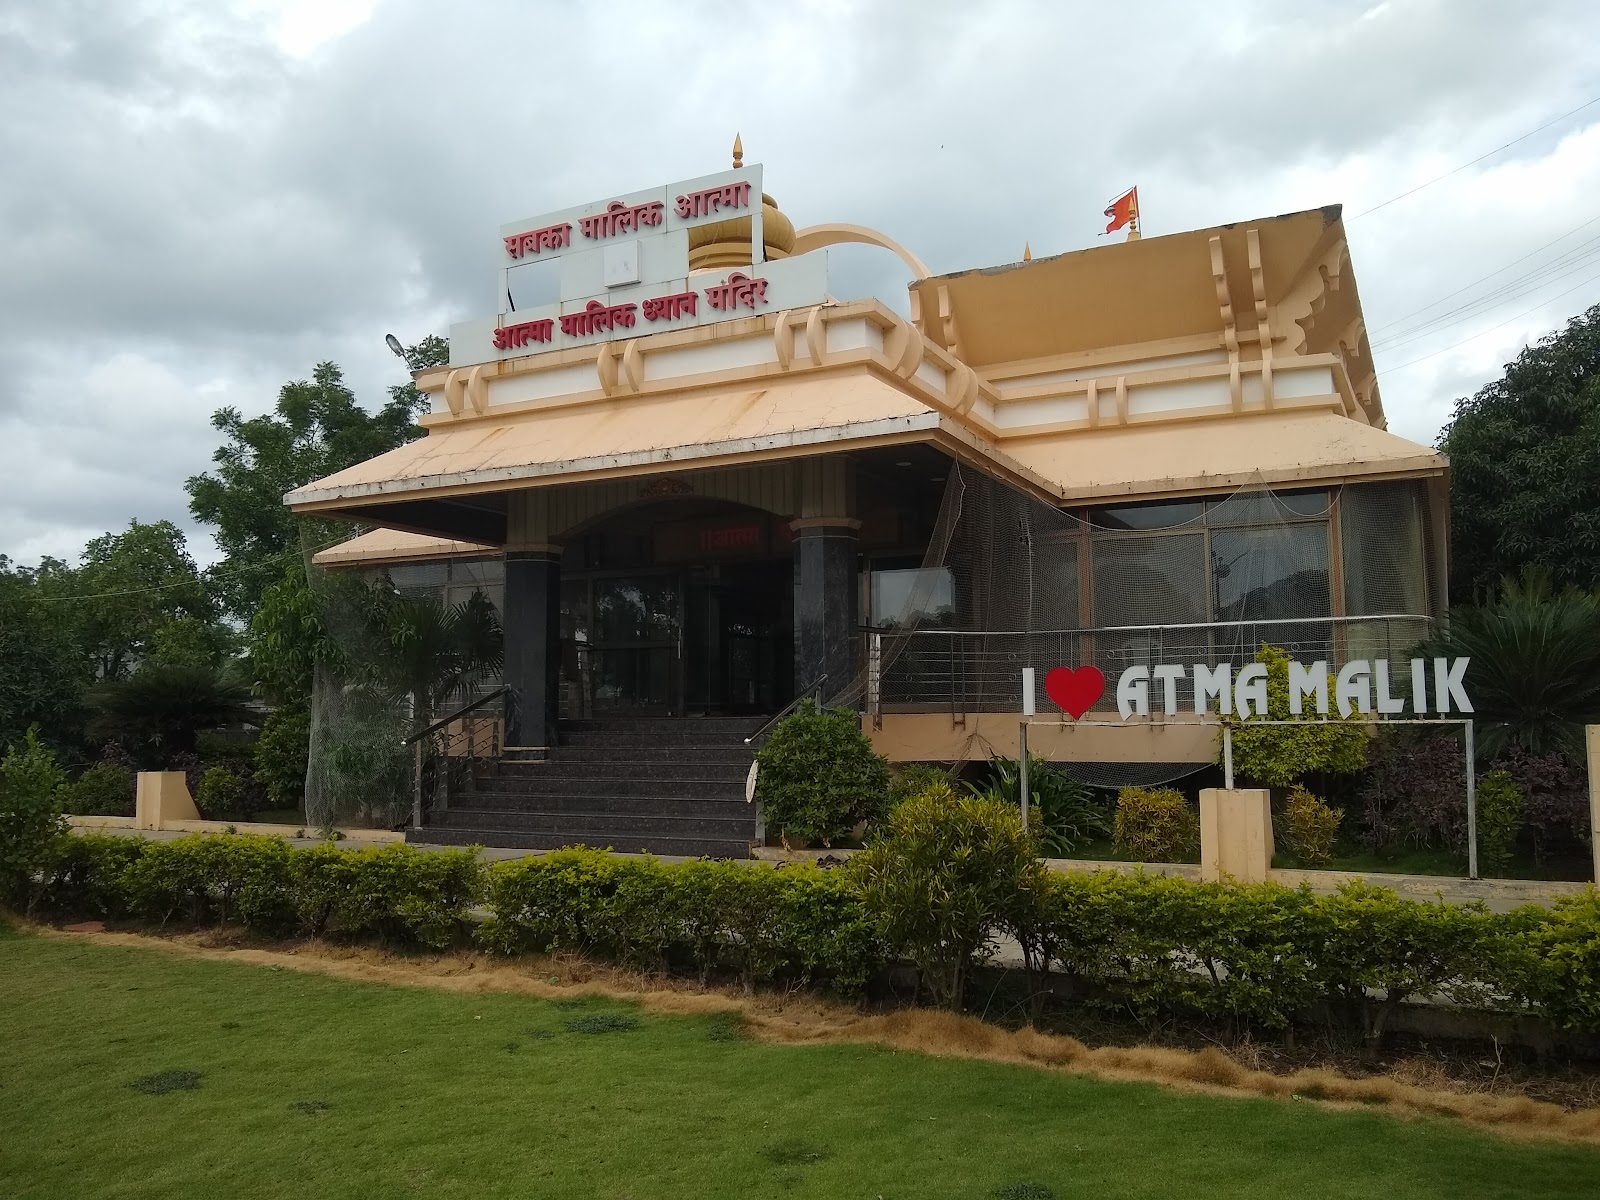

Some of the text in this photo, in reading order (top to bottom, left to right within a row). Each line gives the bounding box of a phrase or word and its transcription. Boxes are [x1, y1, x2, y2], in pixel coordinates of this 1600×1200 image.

[503, 180, 751, 259] सबका मालिक आत्मा
[492, 271, 768, 349] आत्मा मालिक ध्यान मंदिर
[1022, 657, 1474, 721] I ATMA MALIK
